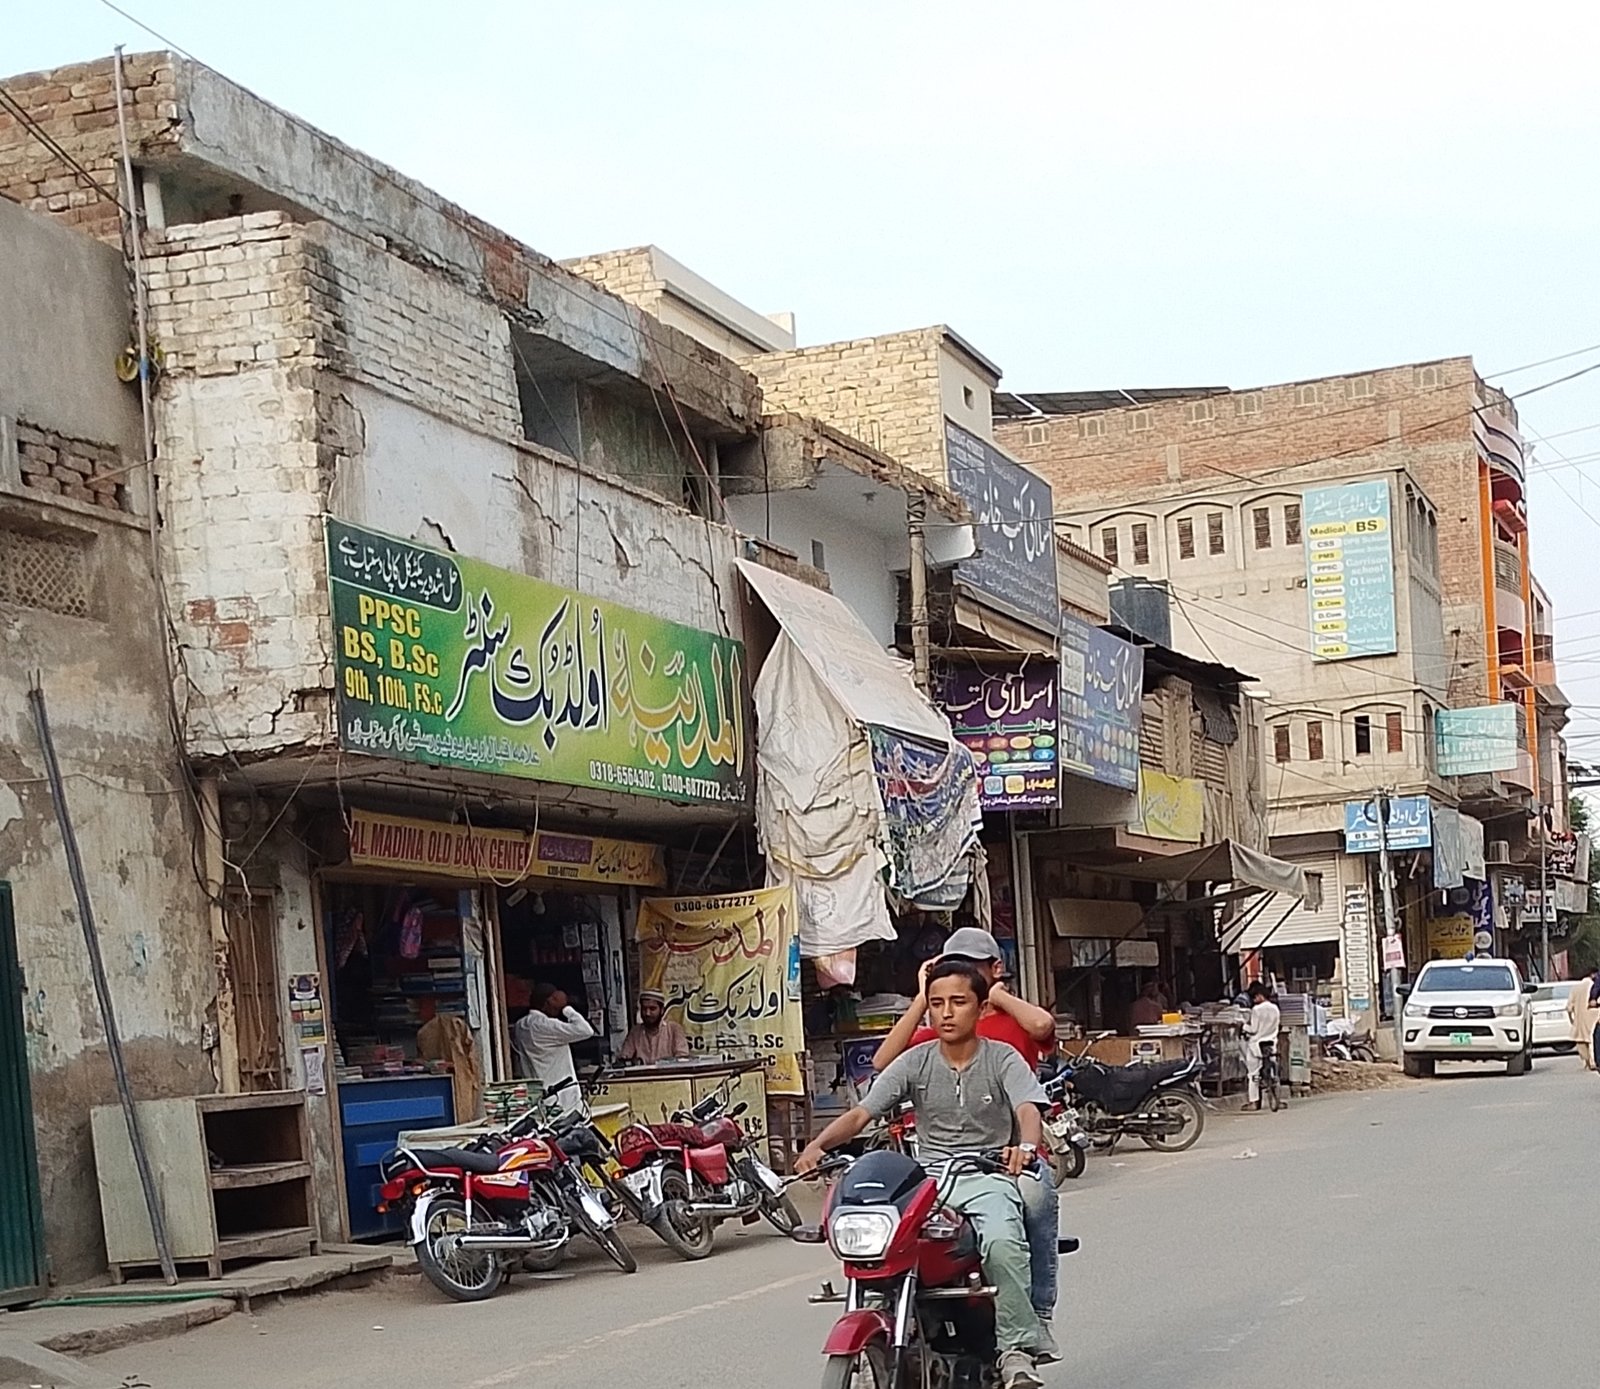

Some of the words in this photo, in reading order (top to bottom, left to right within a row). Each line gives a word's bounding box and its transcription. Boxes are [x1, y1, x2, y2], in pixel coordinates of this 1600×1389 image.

[1309, 525, 1346, 535] Medical
[1356, 519, 1378, 533] BS
[359, 594, 421, 638] PPSC
[390, 639, 440, 678] B.Sc
[985, 679, 1054, 719] اسلامی
[351, 820, 366, 855] AL
[370, 822, 424, 861] MADINA
[427, 830, 451, 864] OLD
